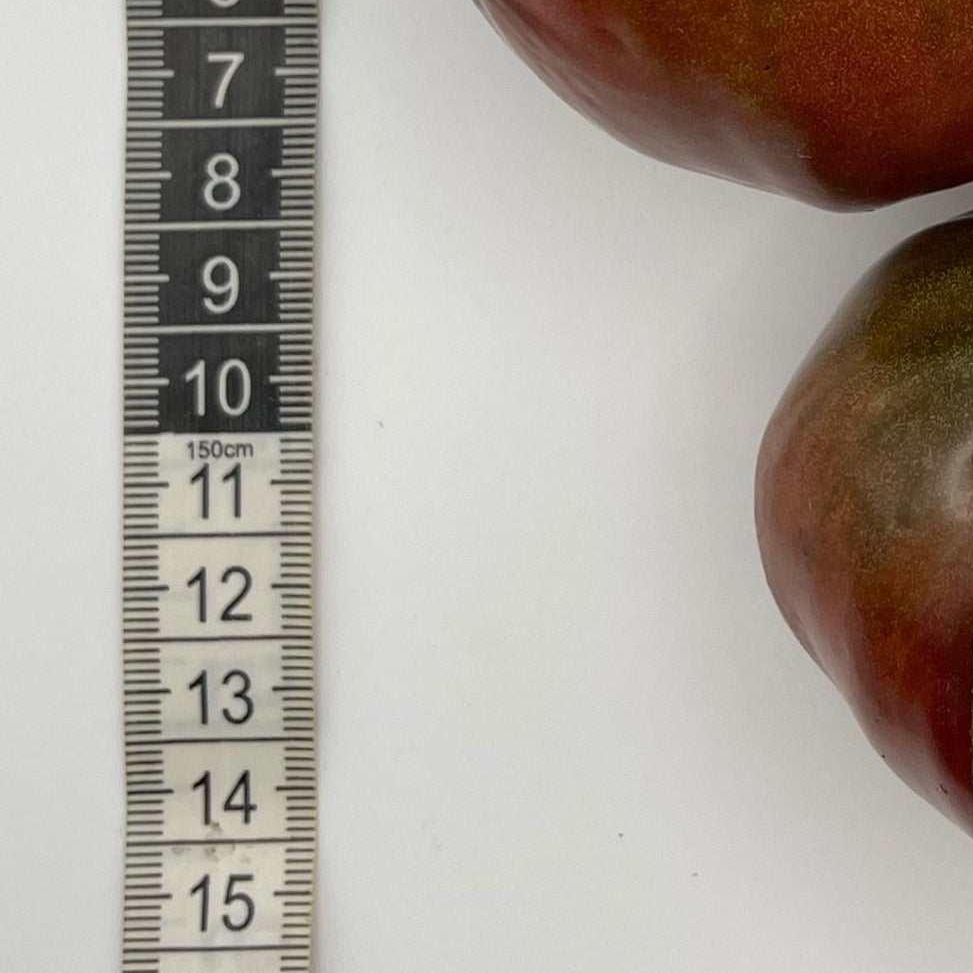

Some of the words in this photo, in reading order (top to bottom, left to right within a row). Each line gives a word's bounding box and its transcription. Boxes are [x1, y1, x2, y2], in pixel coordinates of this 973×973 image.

[207, 52, 245, 108] 7
[203, 152, 241, 211] 8
[202, 255, 240, 314] 9
[185, 358, 251, 416] 10
[187, 440, 253, 459] 150cm
[189, 462, 242, 520] 11
[186, 565, 253, 624] 12
[188, 669, 254, 726] 13
[191, 769, 258, 826] 14
[190, 873, 255, 933] 15
